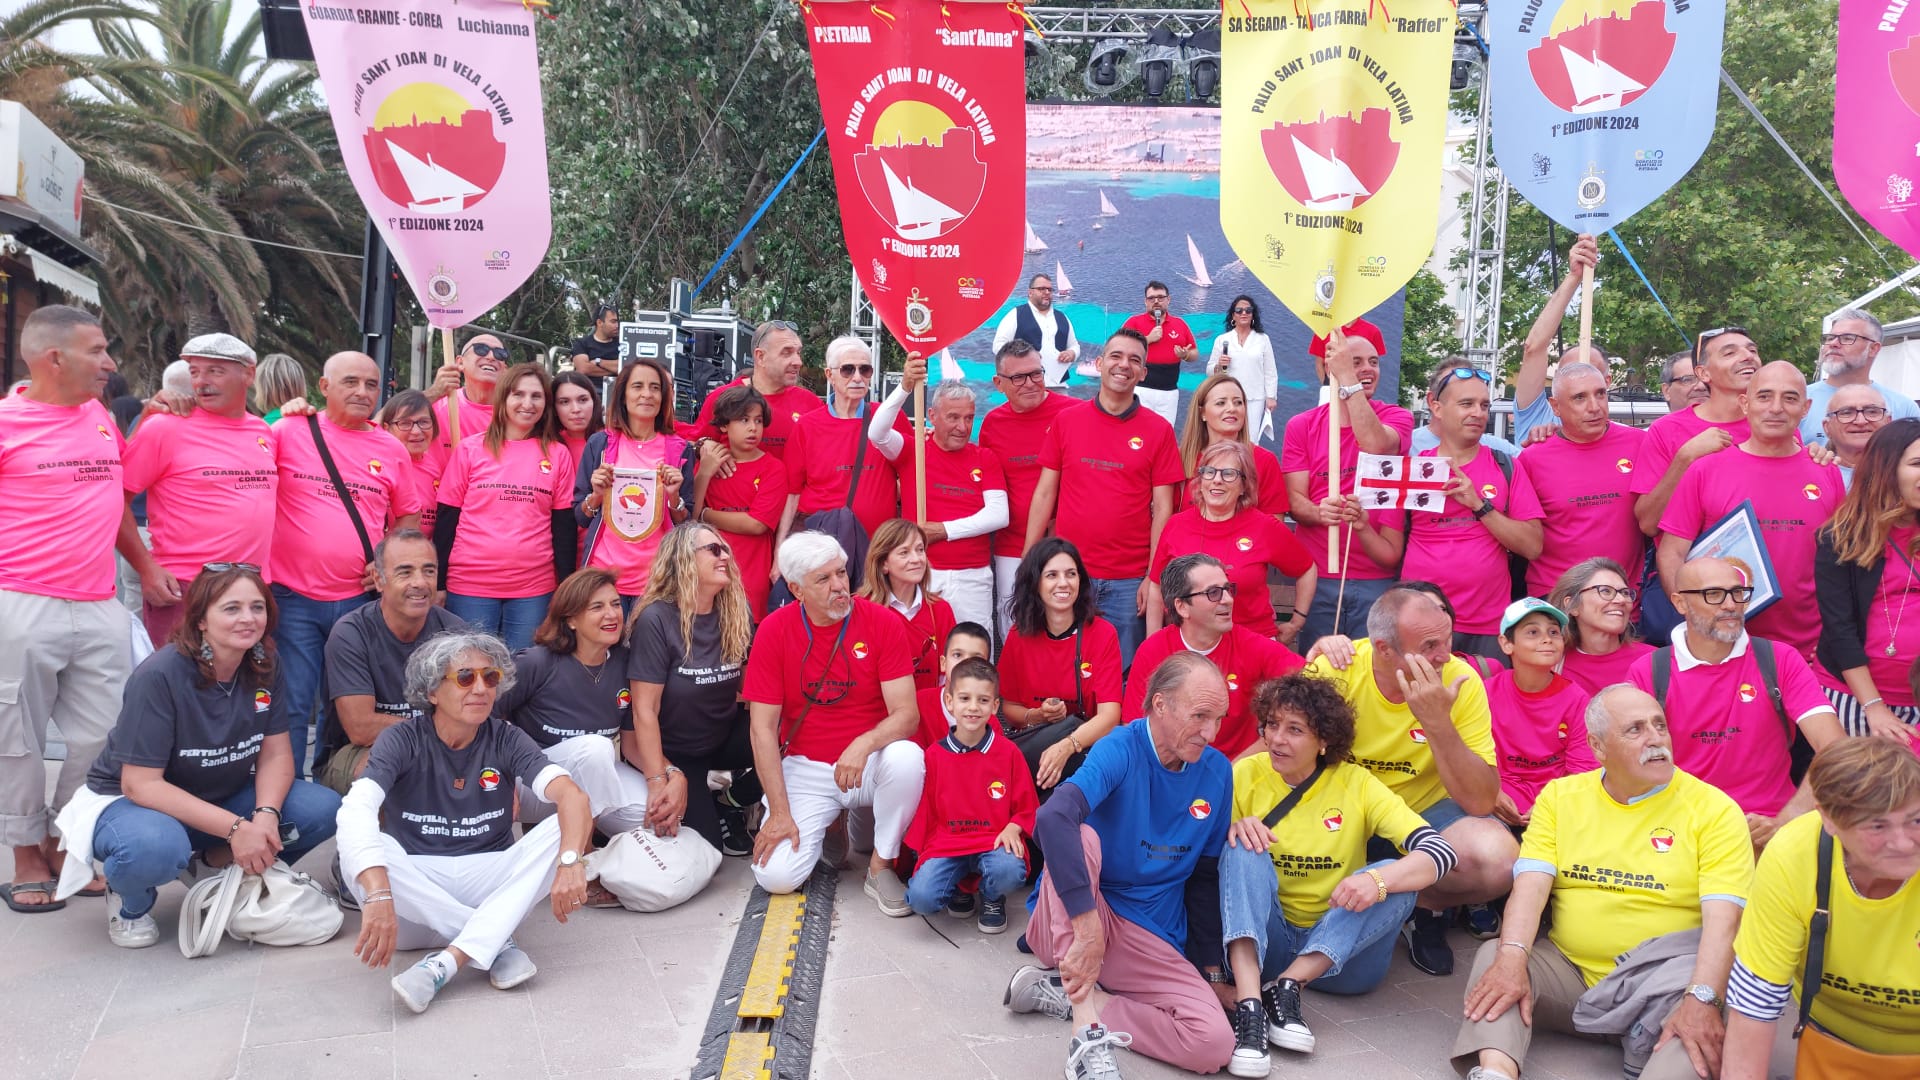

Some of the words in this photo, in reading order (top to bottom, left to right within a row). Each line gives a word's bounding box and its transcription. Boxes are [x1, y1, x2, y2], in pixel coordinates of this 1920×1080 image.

[309, 6, 356, 23] GUARDIA
[356, 10, 400, 25] GRANDE
[409, 11, 443, 29] COREA
[1877, 0, 1910, 32] PALI
[458, 17, 530, 37] Luchianna
[1228, 16, 1243, 33] SA
[1245, 16, 1287, 32] SEGADA
[814, 26, 871, 43] PIETRAIA
[361, 58, 391, 85] SANT
[395, 51, 427, 68] JOAN
[433, 53, 447, 68] DI
[453, 60, 482, 86] VELA
[482, 83, 514, 126] LATINA
[1251, 80, 1277, 114] PALIO
[1274, 57, 1305, 82] SANT
[1309, 45, 1342, 66] JOAN
[1348, 46, 1361, 62] DI
[1362, 54, 1388, 84] VELA
[1385, 81, 1413, 125] LATINA
[845, 100, 866, 138] PALIO
[861, 74, 886, 103] SANT
[887, 67, 911, 85] JOAN
[917, 68, 932, 84] DI
[937, 73, 966, 102] VELA
[965, 98, 996, 146] LATINA
[1563, 116, 1608, 136] EDIZIONE
[1610, 116, 1639, 130] 2024
[400, 218, 451, 231] EDIZIONE
[454, 218, 484, 231] 2024
[1296, 213, 1345, 230] EDIZIONE
[930, 244, 960, 258] 2024
[37, 459, 91, 470] GUARDIA
[95, 459, 121, 467] GRAN
[78, 466, 111, 474] COREA
[73, 473, 114, 483] Luchianna
[293, 473, 333, 484] GUARD
[504, 489, 534, 497] COREA
[522, 485, 553, 496] GRANDE
[695, 674, 717, 685] Santa
[542, 724, 586, 736] FERTILIA
[179, 746, 228, 758] FERTILIA
[200, 754, 228, 768] Santa
[230, 744, 261, 763] Barbara
[402, 811, 447, 825] FERTILIA
[421, 824, 450, 836] Santa
[452, 824, 489, 837] Barbara
[1279, 854, 1332, 862] SEGADA
[1283, 869, 1308, 877] Raffel
[1561, 871, 1607, 883] TANCA
[1572, 864, 1589, 873] SA
[1596, 868, 1655, 881] SEGADA
[1821, 978, 1876, 998] ANCA
[1824, 972, 1849, 985] SA
[1858, 983, 1920, 997] SEGAD
